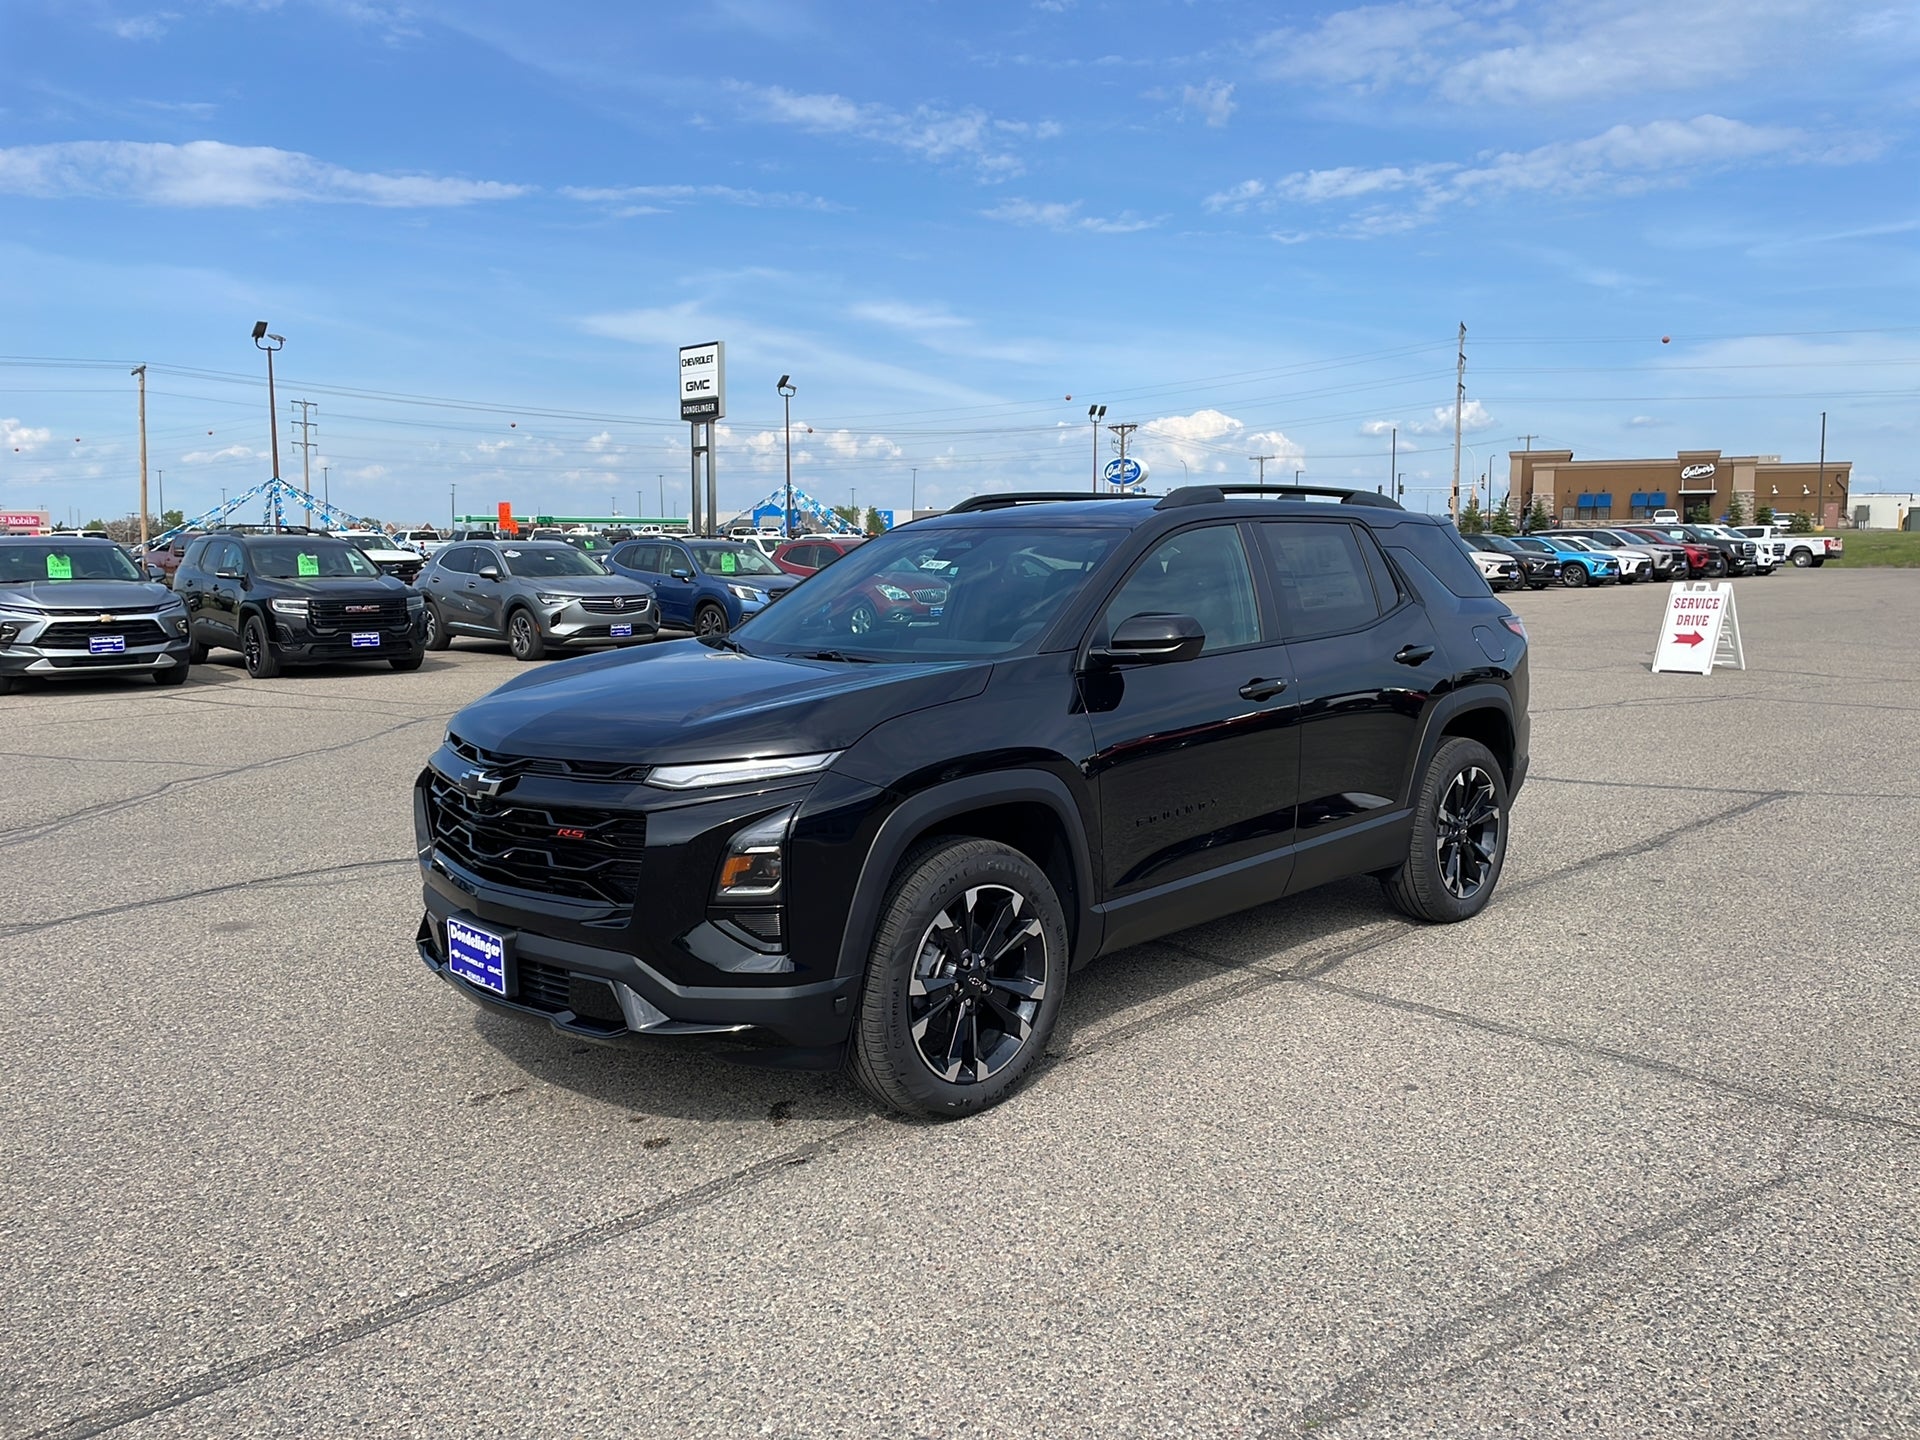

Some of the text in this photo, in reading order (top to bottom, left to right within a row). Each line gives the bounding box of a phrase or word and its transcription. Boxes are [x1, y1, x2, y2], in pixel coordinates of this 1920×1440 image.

[681, 355, 714, 368] CHEVROLET
[685, 379, 711, 392] GMC
[683, 403, 715, 415] DONDELINGER
[8, 516, 37, 525] Mobile
[1673, 597, 1720, 609] SERVICE
[1676, 614, 1710, 627] DRIVE
[557, 828, 585, 839] RS
